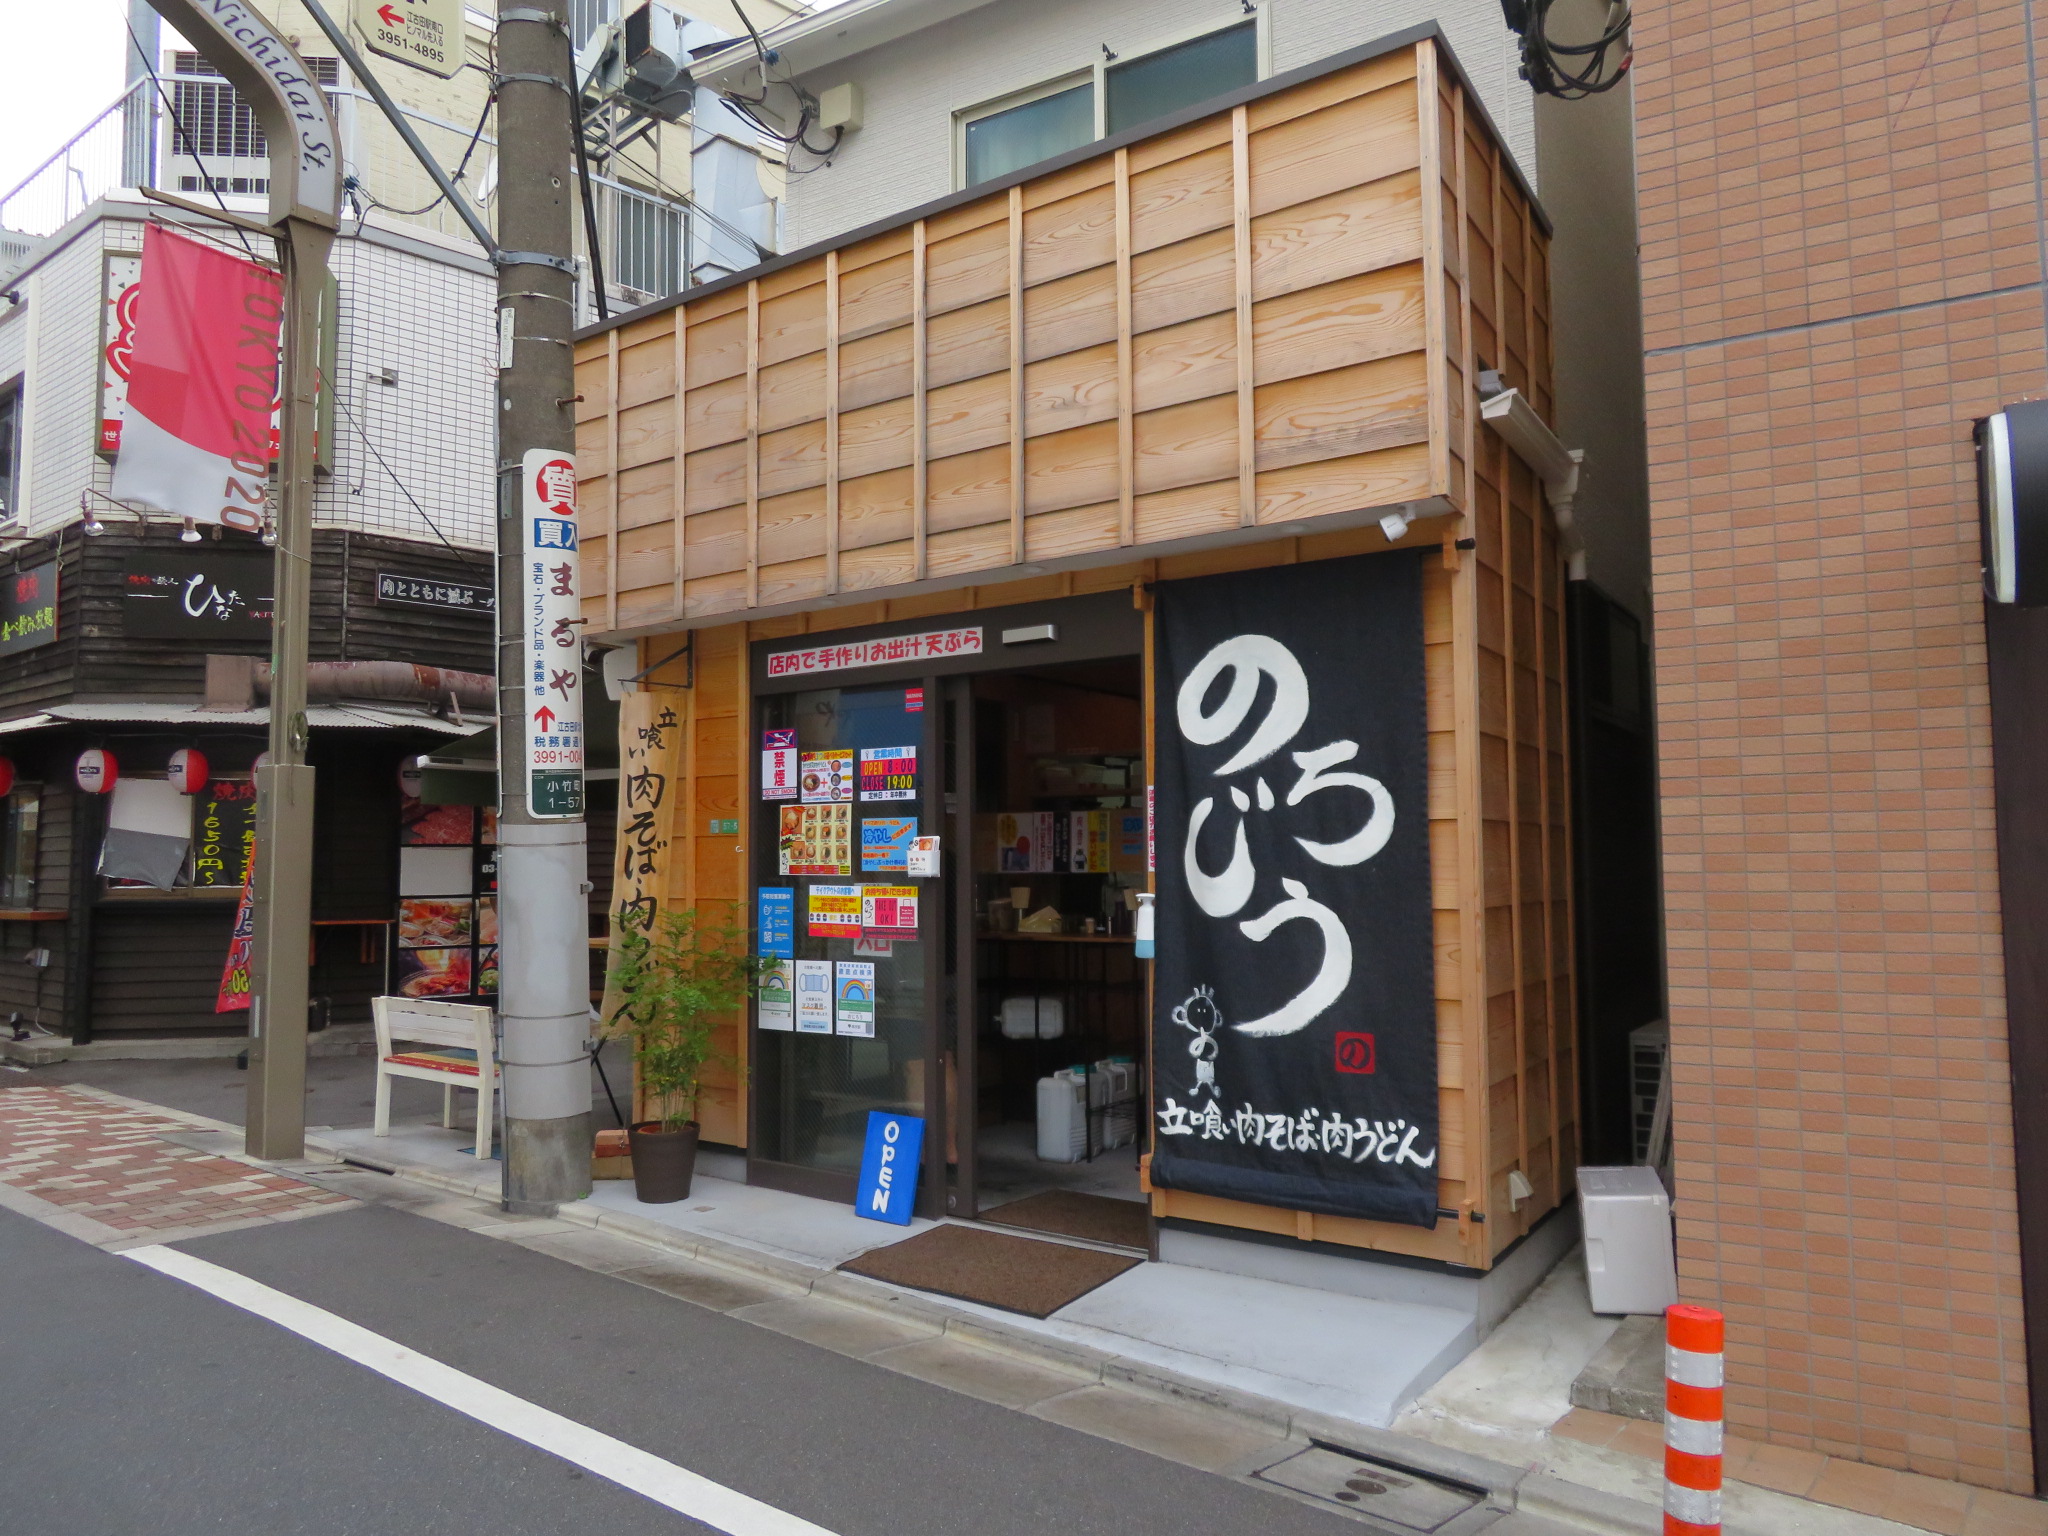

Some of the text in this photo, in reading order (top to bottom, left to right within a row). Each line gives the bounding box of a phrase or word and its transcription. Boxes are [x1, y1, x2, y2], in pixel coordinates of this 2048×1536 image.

[406, 11, 443, 34] 江古田駅南口
[377, 29, 444, 63] 3951-4895
[302, 132, 332, 171] St.
[220, 267, 285, 533] TOKYO 2020
[541, 464, 577, 508] 質
[549, 561, 578, 703] まるや
[773, 751, 786, 787] 禁煙
[861, 774, 913, 791] CLOSE 19:00
[864, 761, 883, 775] OPEN
[1176, 634, 1396, 1037] のじろう
[872, 1120, 901, 1215] OPEN
